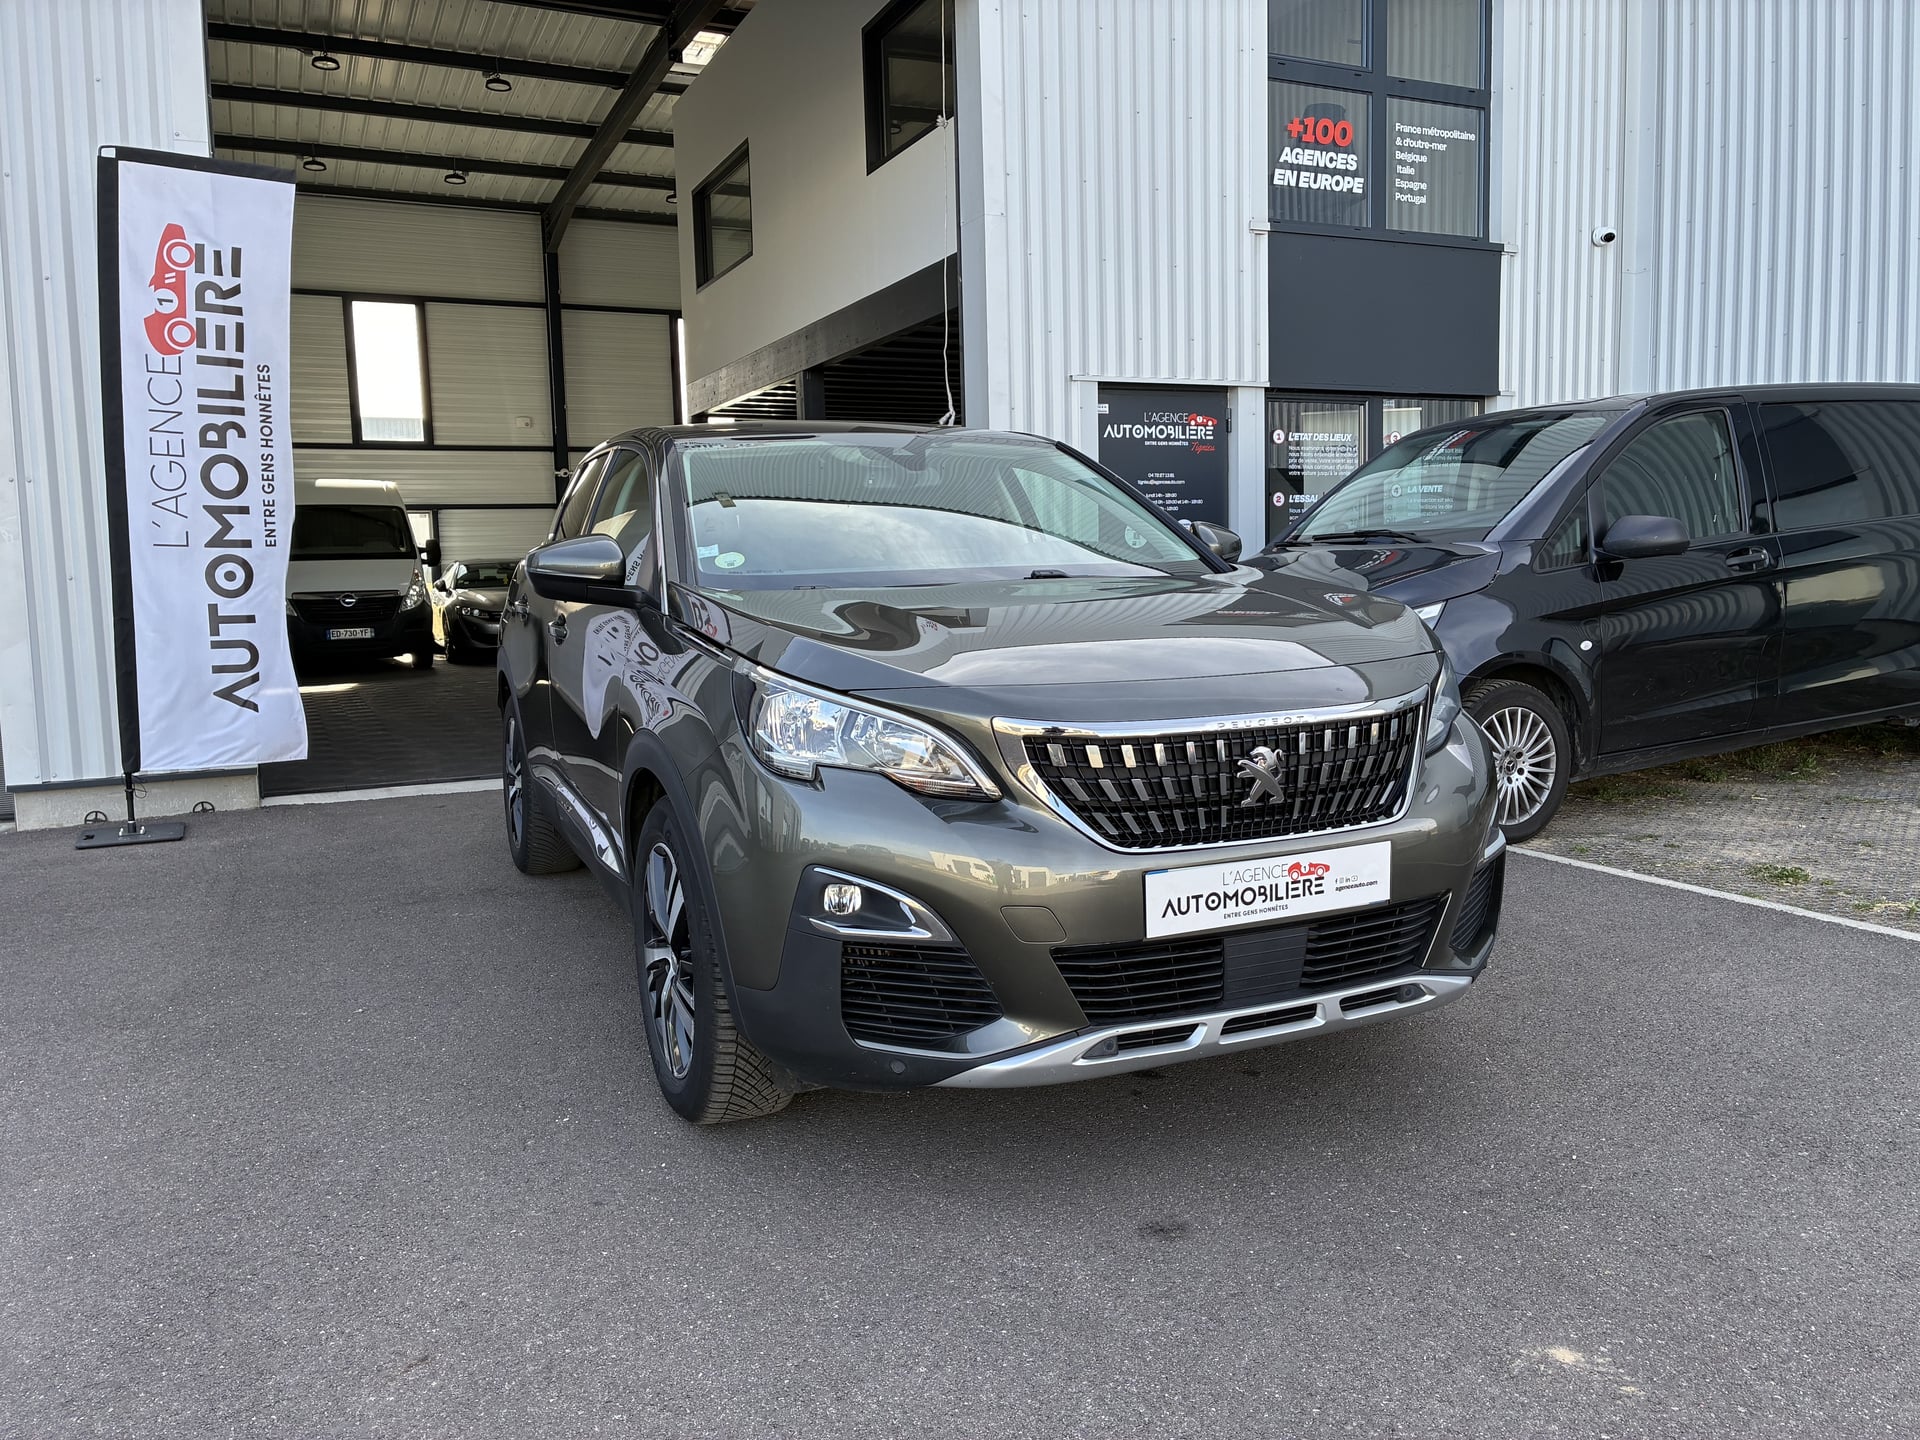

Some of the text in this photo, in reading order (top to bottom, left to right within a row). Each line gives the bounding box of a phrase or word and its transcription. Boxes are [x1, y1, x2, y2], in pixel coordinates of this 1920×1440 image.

[1287, 117, 1353, 147] +100
[1395, 123, 1476, 141] France métropolitaine
[1395, 137, 1447, 151] & d'outre-mer
[1279, 147, 1358, 171] AGENCES
[1395, 151, 1427, 163] Belgique
[1397, 165, 1415, 175] Italie
[1273, 168, 1364, 194] EN EUROPE
[1395, 178, 1427, 191] Espagne
[1395, 192, 1426, 204] Portugal
[1144, 412, 1188, 423] L'AGENCE
[1313, 433, 1329, 441] DES
[1330, 433, 1352, 442] LIEUX
[145, 353, 190, 547] L'AGENCE
[254, 364, 277, 547] ENTRE GENS HONNÊTES
[1407, 485, 1443, 494] LA VENTE
[1289, 494, 1319, 503] L'ESSAI
[331, 628, 369, 638] ED-730-YF
[1217, 715, 1305, 729] PEUGEOT
[1222, 863, 1289, 886] L'AGENCE
[1223, 904, 1289, 919] ENTRE GENS HONNÊTES
